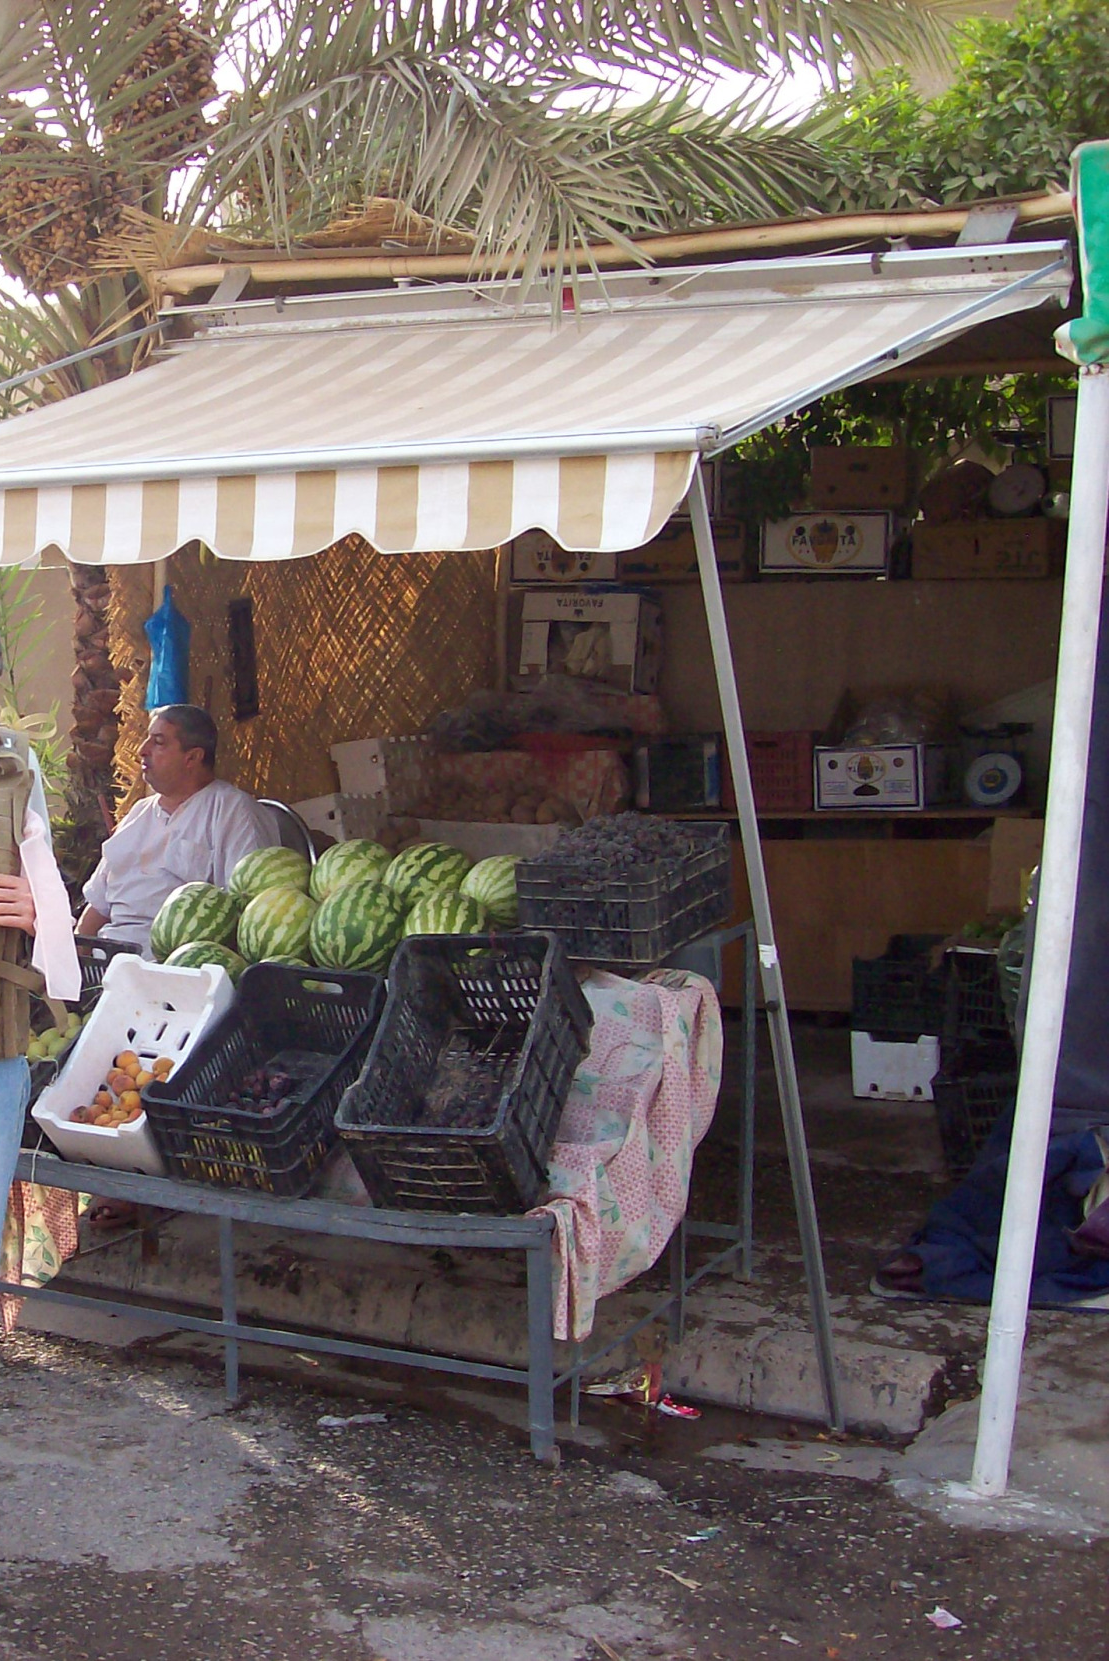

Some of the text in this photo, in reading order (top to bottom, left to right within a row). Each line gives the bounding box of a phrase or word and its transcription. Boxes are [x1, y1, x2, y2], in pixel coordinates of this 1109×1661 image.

[791, 535, 856, 545] FAVTA
[536, 551, 592, 561] FATA
[556, 598, 604, 608] FAVORITA
